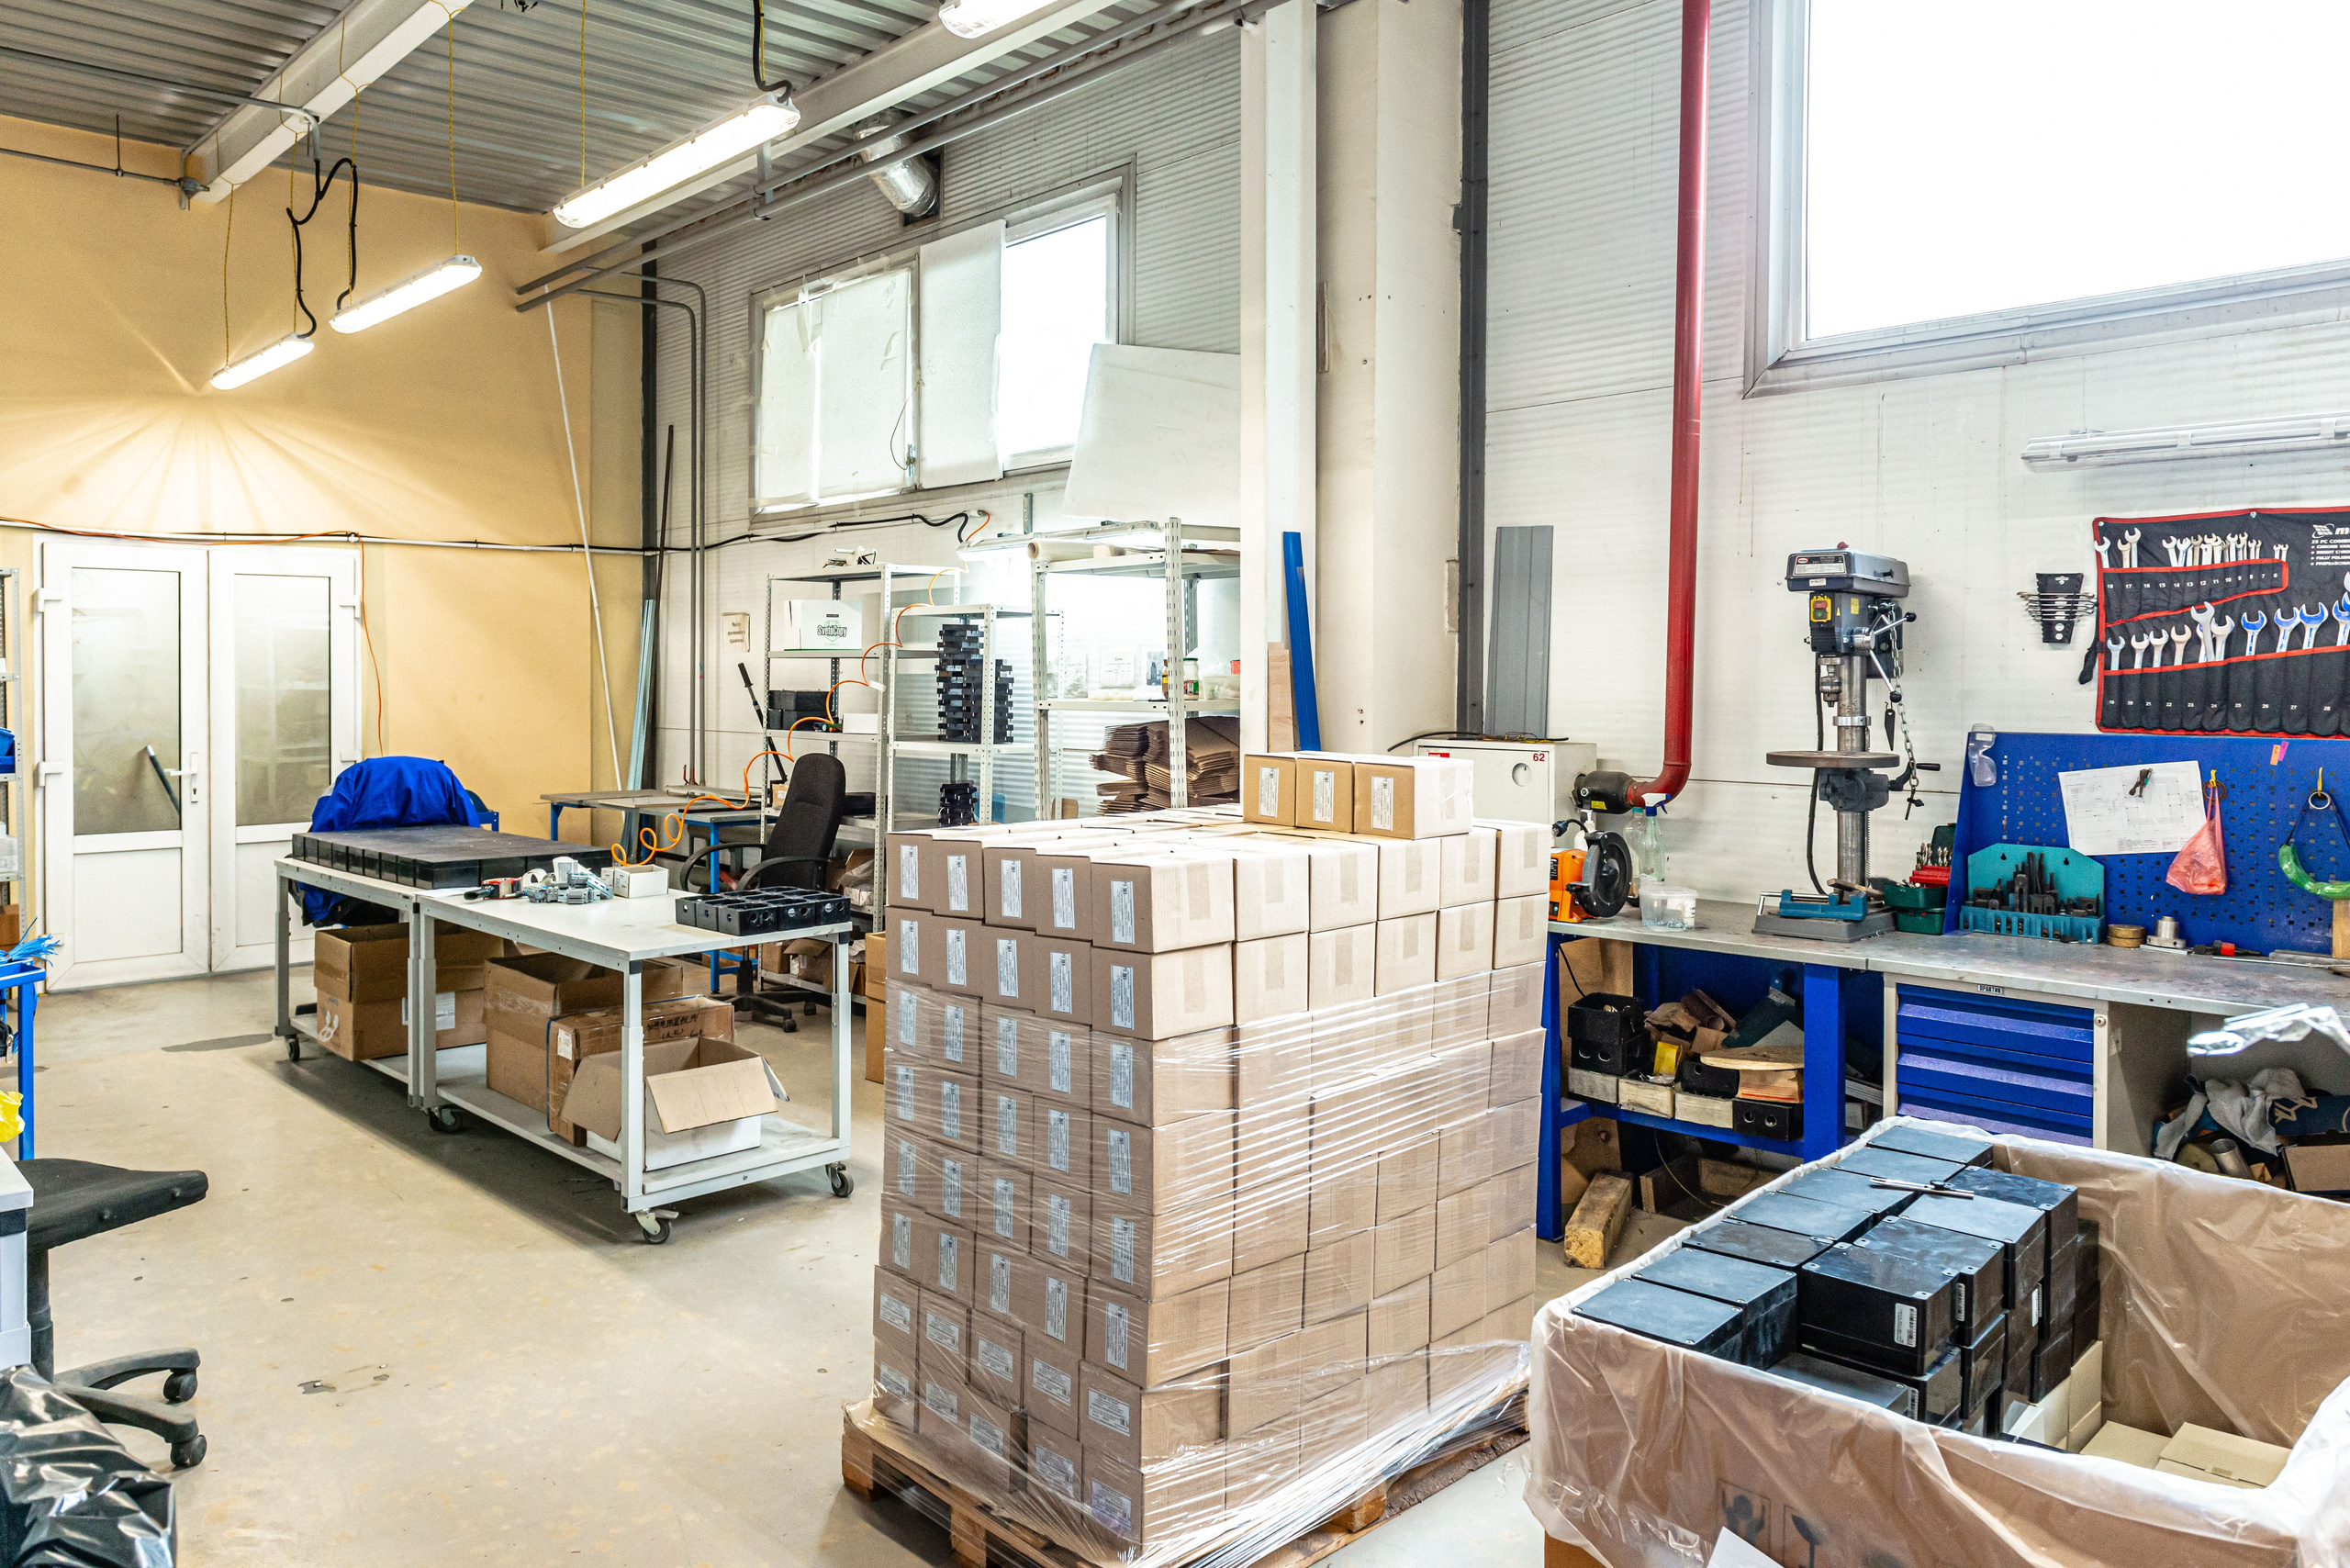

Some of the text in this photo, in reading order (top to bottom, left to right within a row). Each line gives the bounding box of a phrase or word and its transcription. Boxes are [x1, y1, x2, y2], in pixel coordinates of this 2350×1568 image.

[2334, 527, 2350, 535] m
[817, 624, 847, 637] SvetoCopy
[1532, 753, 1545, 762] 62
